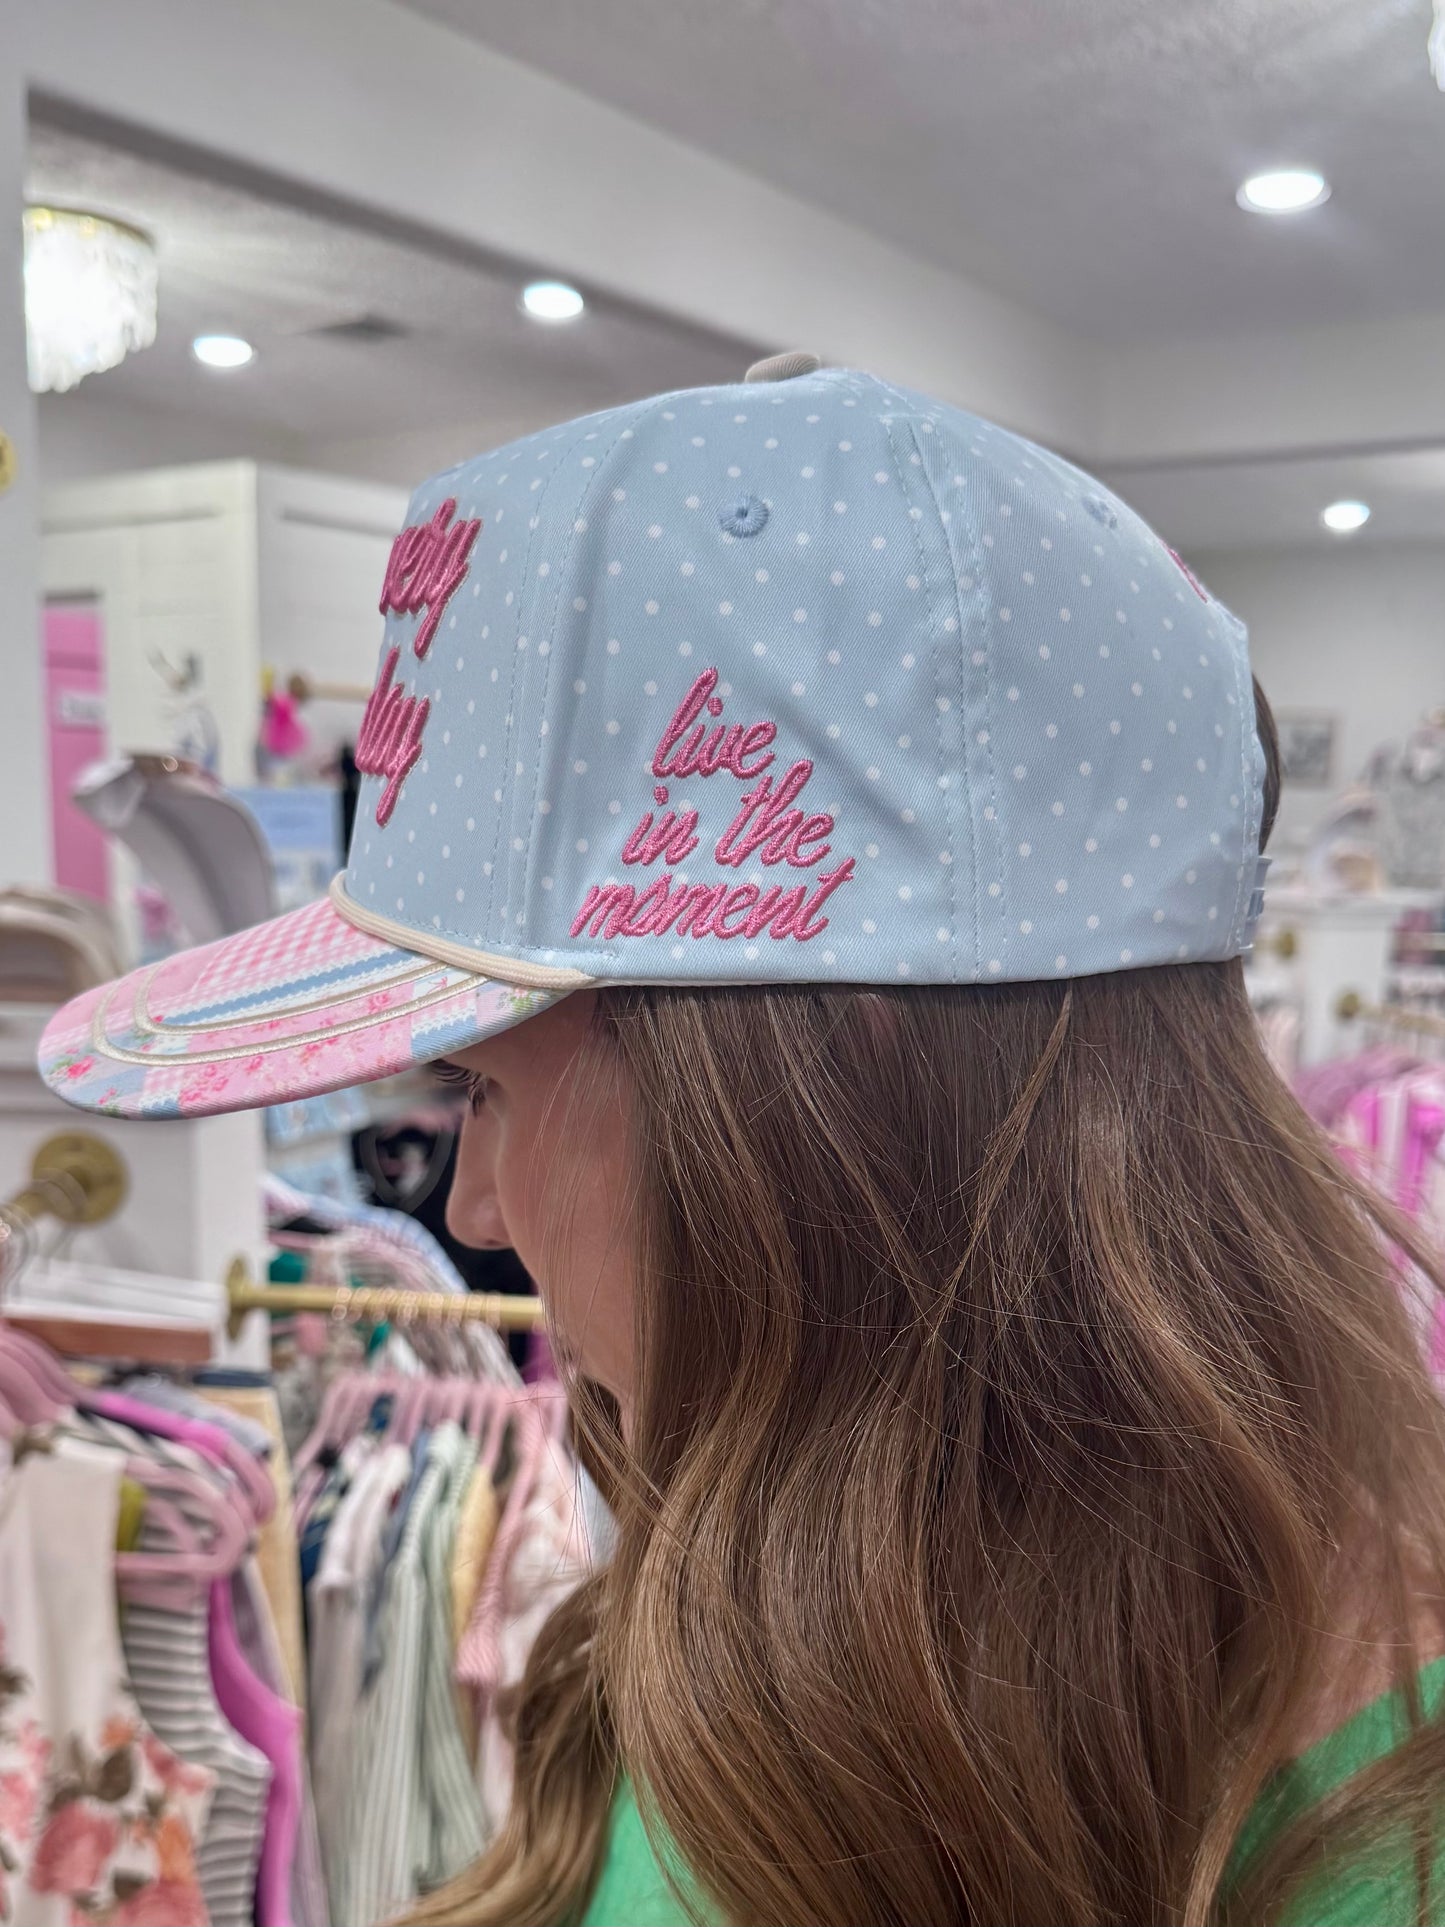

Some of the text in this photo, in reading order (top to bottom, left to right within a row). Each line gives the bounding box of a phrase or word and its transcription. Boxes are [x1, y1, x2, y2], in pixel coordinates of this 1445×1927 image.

[652, 667, 777, 779] live
[621, 759, 834, 867] in the
[570, 857, 855, 941] moment
